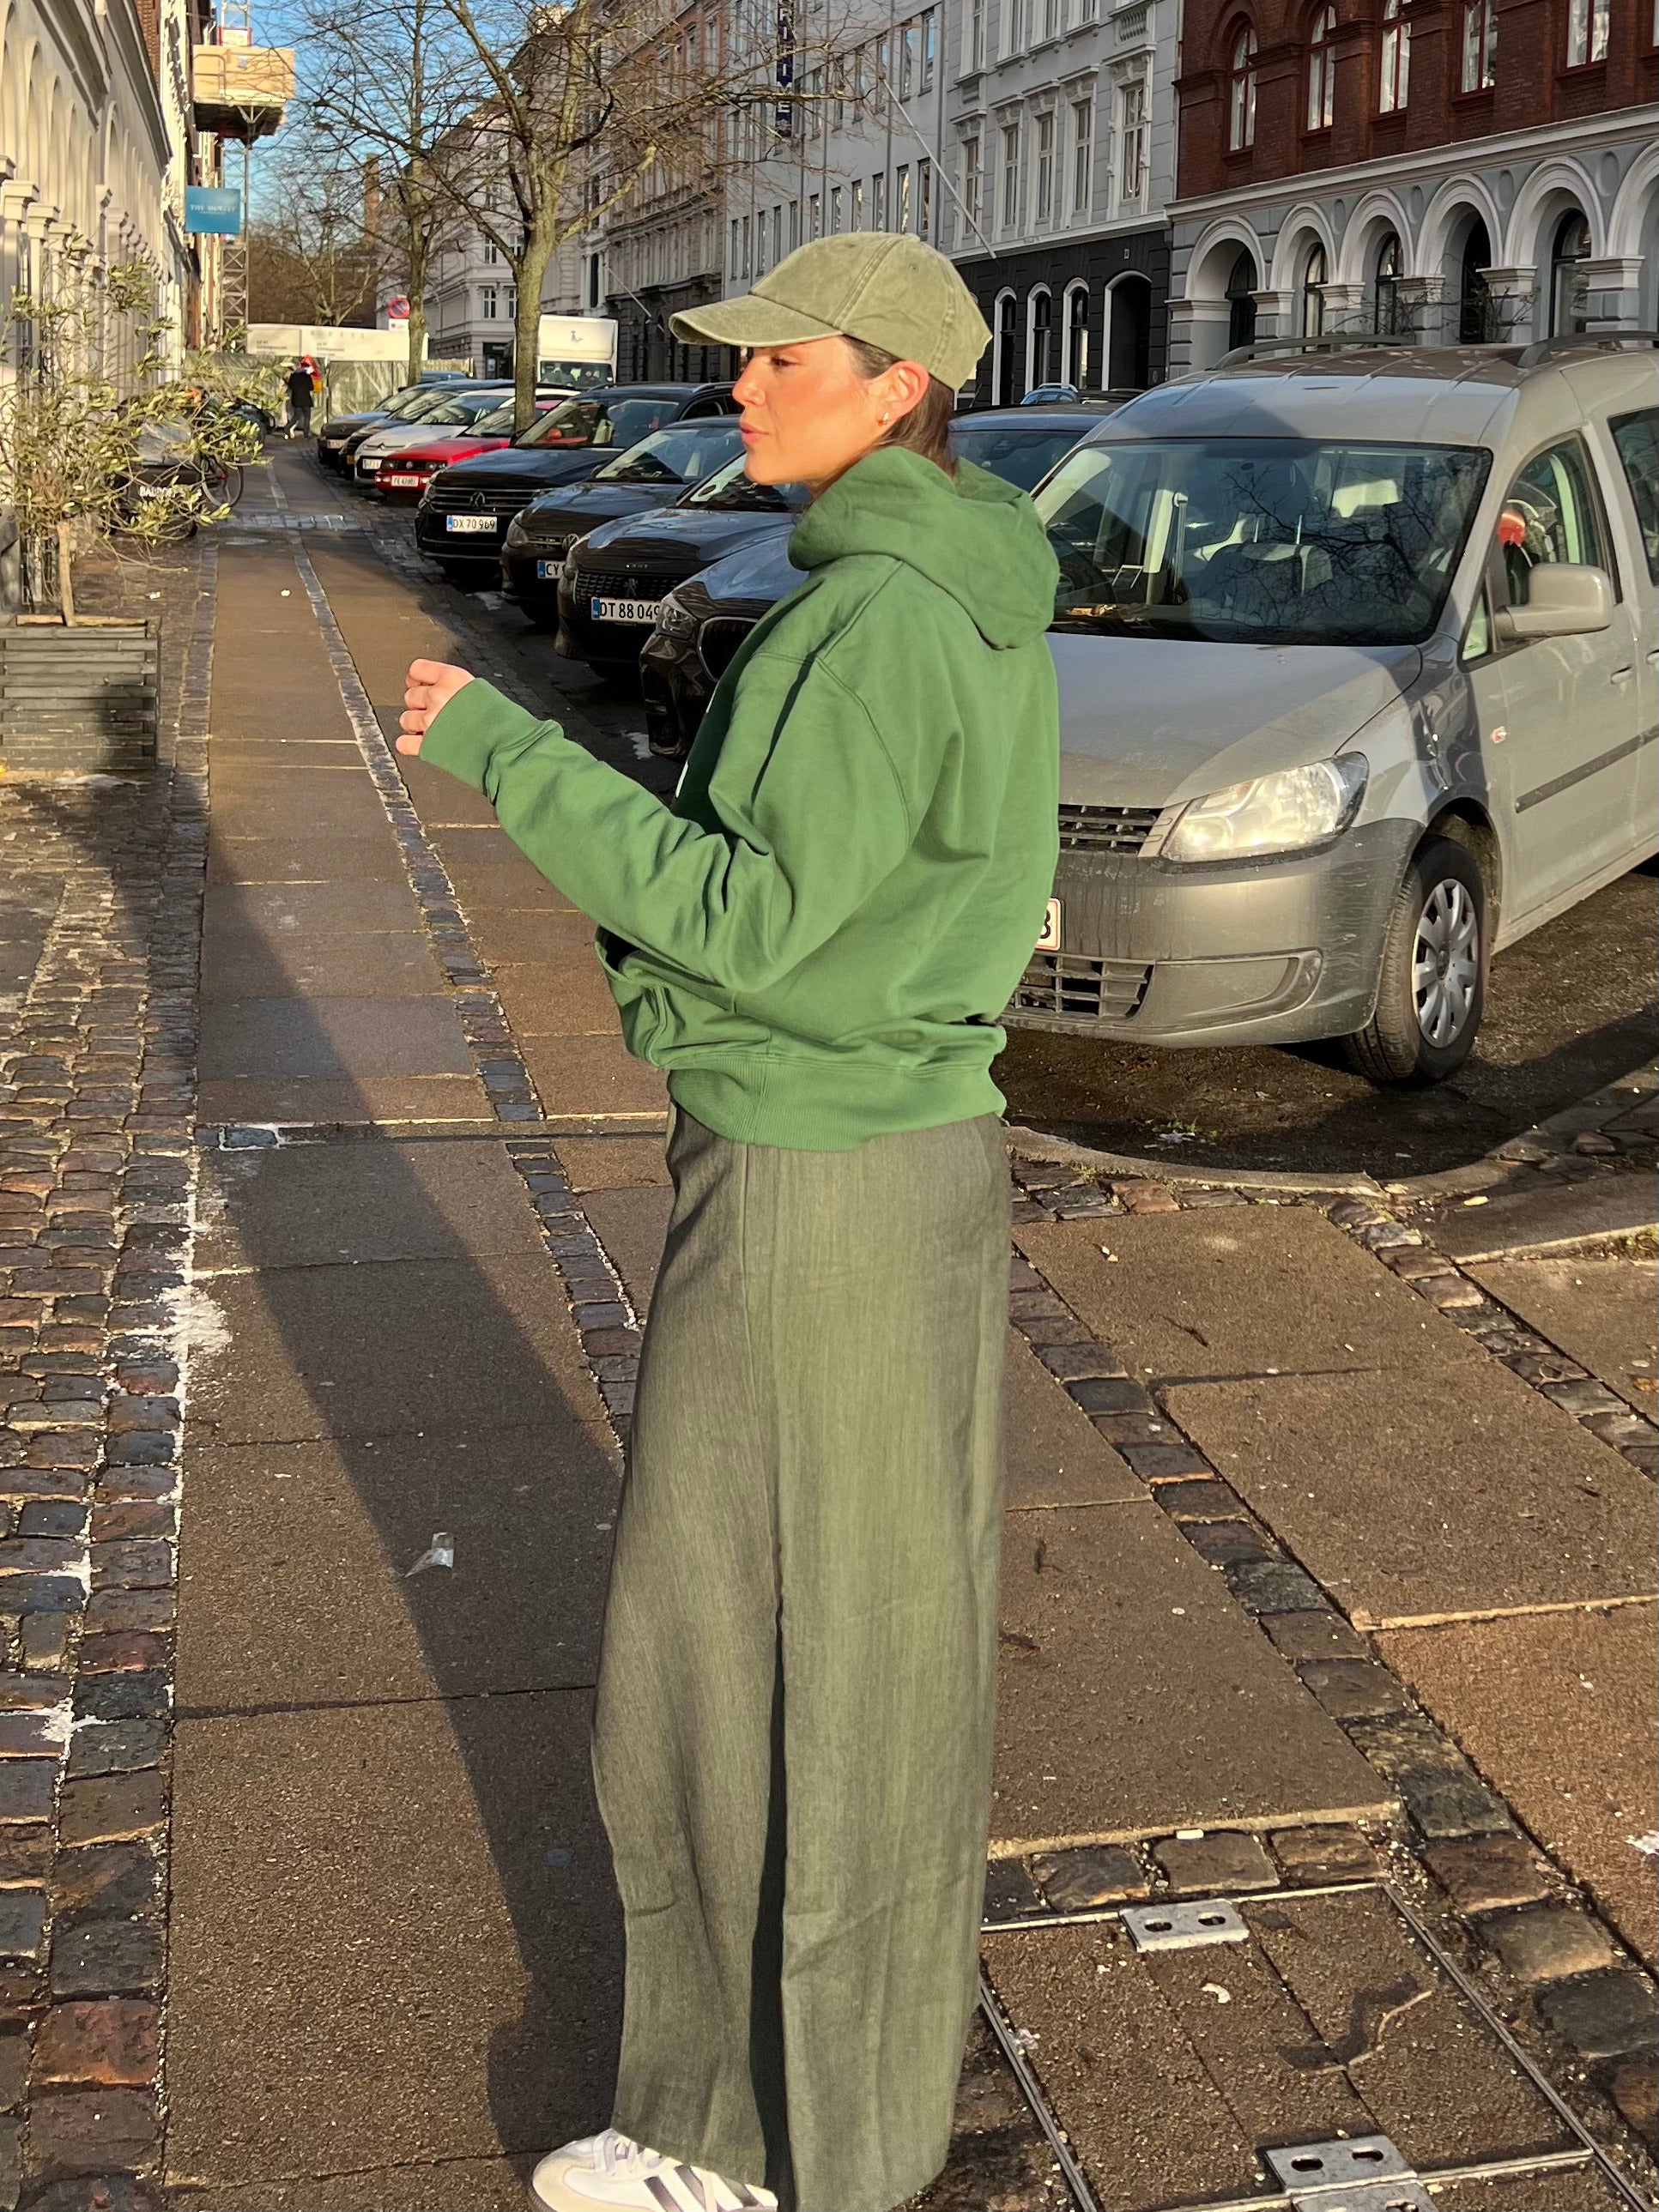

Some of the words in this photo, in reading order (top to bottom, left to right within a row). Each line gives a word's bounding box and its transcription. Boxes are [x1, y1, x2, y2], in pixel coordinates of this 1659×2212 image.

[453, 519, 464, 529] DX
[466, 519, 476, 529] 70
[478, 519, 495, 529] 969
[546, 564, 559, 576] CY
[601, 602, 616, 617] DT
[619, 603, 634, 619] 88
